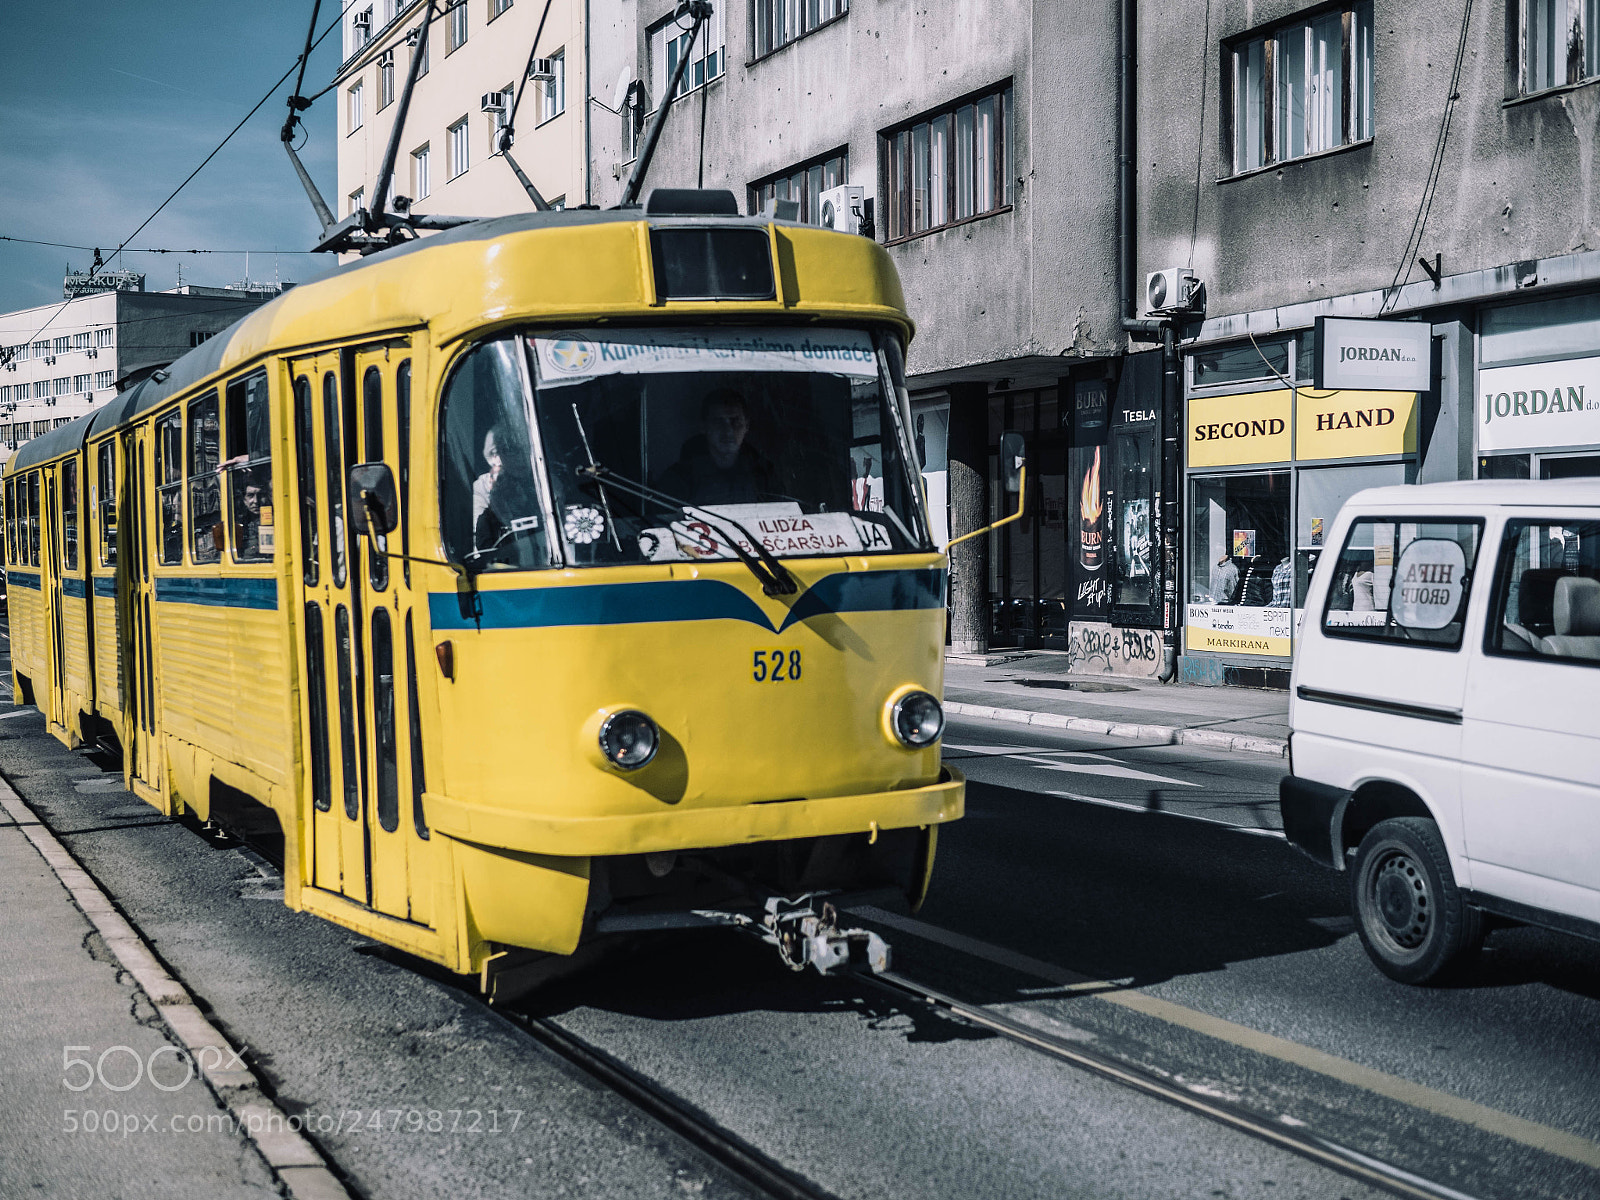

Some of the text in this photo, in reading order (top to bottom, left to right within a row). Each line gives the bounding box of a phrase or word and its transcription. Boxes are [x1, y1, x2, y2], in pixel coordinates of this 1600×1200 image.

[1340, 346, 1401, 362] JORDAN
[1485, 385, 1585, 424] JORDAN
[1194, 407, 1395, 441] SECOND HAND
[758, 518, 813, 534] ILIDŽA
[686, 522, 719, 556] 3
[738, 534, 848, 554] BŠČARŠIJA
[1081, 530, 1102, 545] BURN
[1078, 577, 1100, 600] LIGHT
[1189, 607, 1209, 618] BOSS
[1263, 610, 1289, 622] ESPRIT
[1269, 626, 1290, 637] next
[1206, 637, 1270, 650] MARKIRANA
[753, 649, 802, 682] 528
